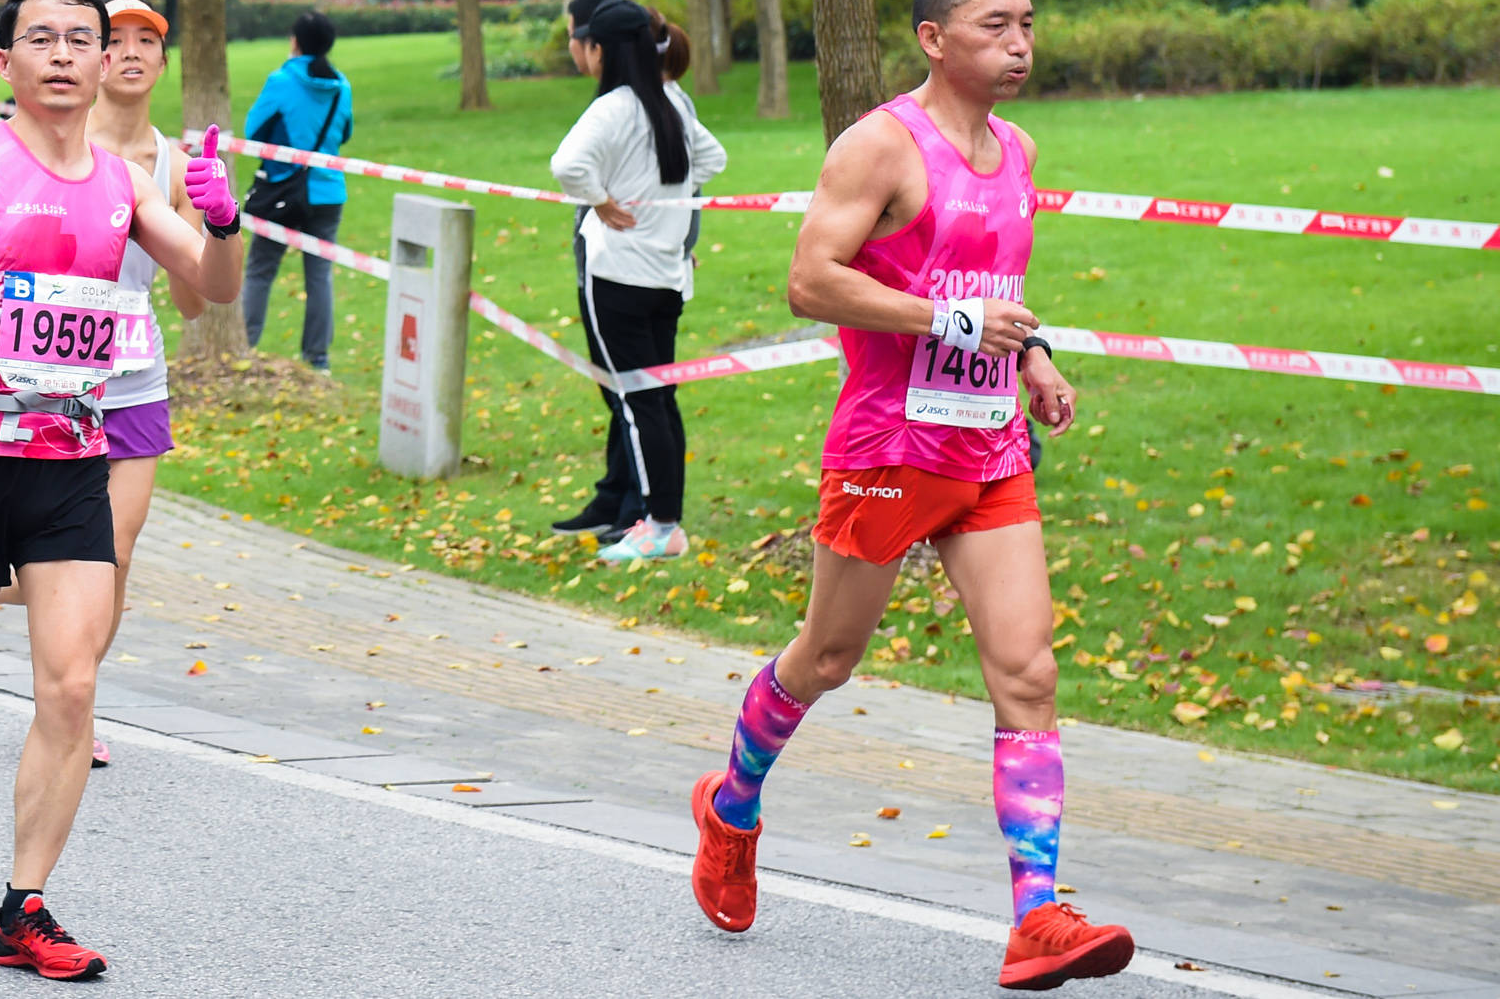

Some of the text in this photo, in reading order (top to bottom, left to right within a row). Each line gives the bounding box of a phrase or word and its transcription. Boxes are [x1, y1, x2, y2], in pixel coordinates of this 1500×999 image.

[14, 279, 30, 298] B
[10, 307, 115, 362] 19592
[925, 339, 1010, 389] 14681
[16, 375, 38, 386] asics
[927, 406, 949, 416] asics
